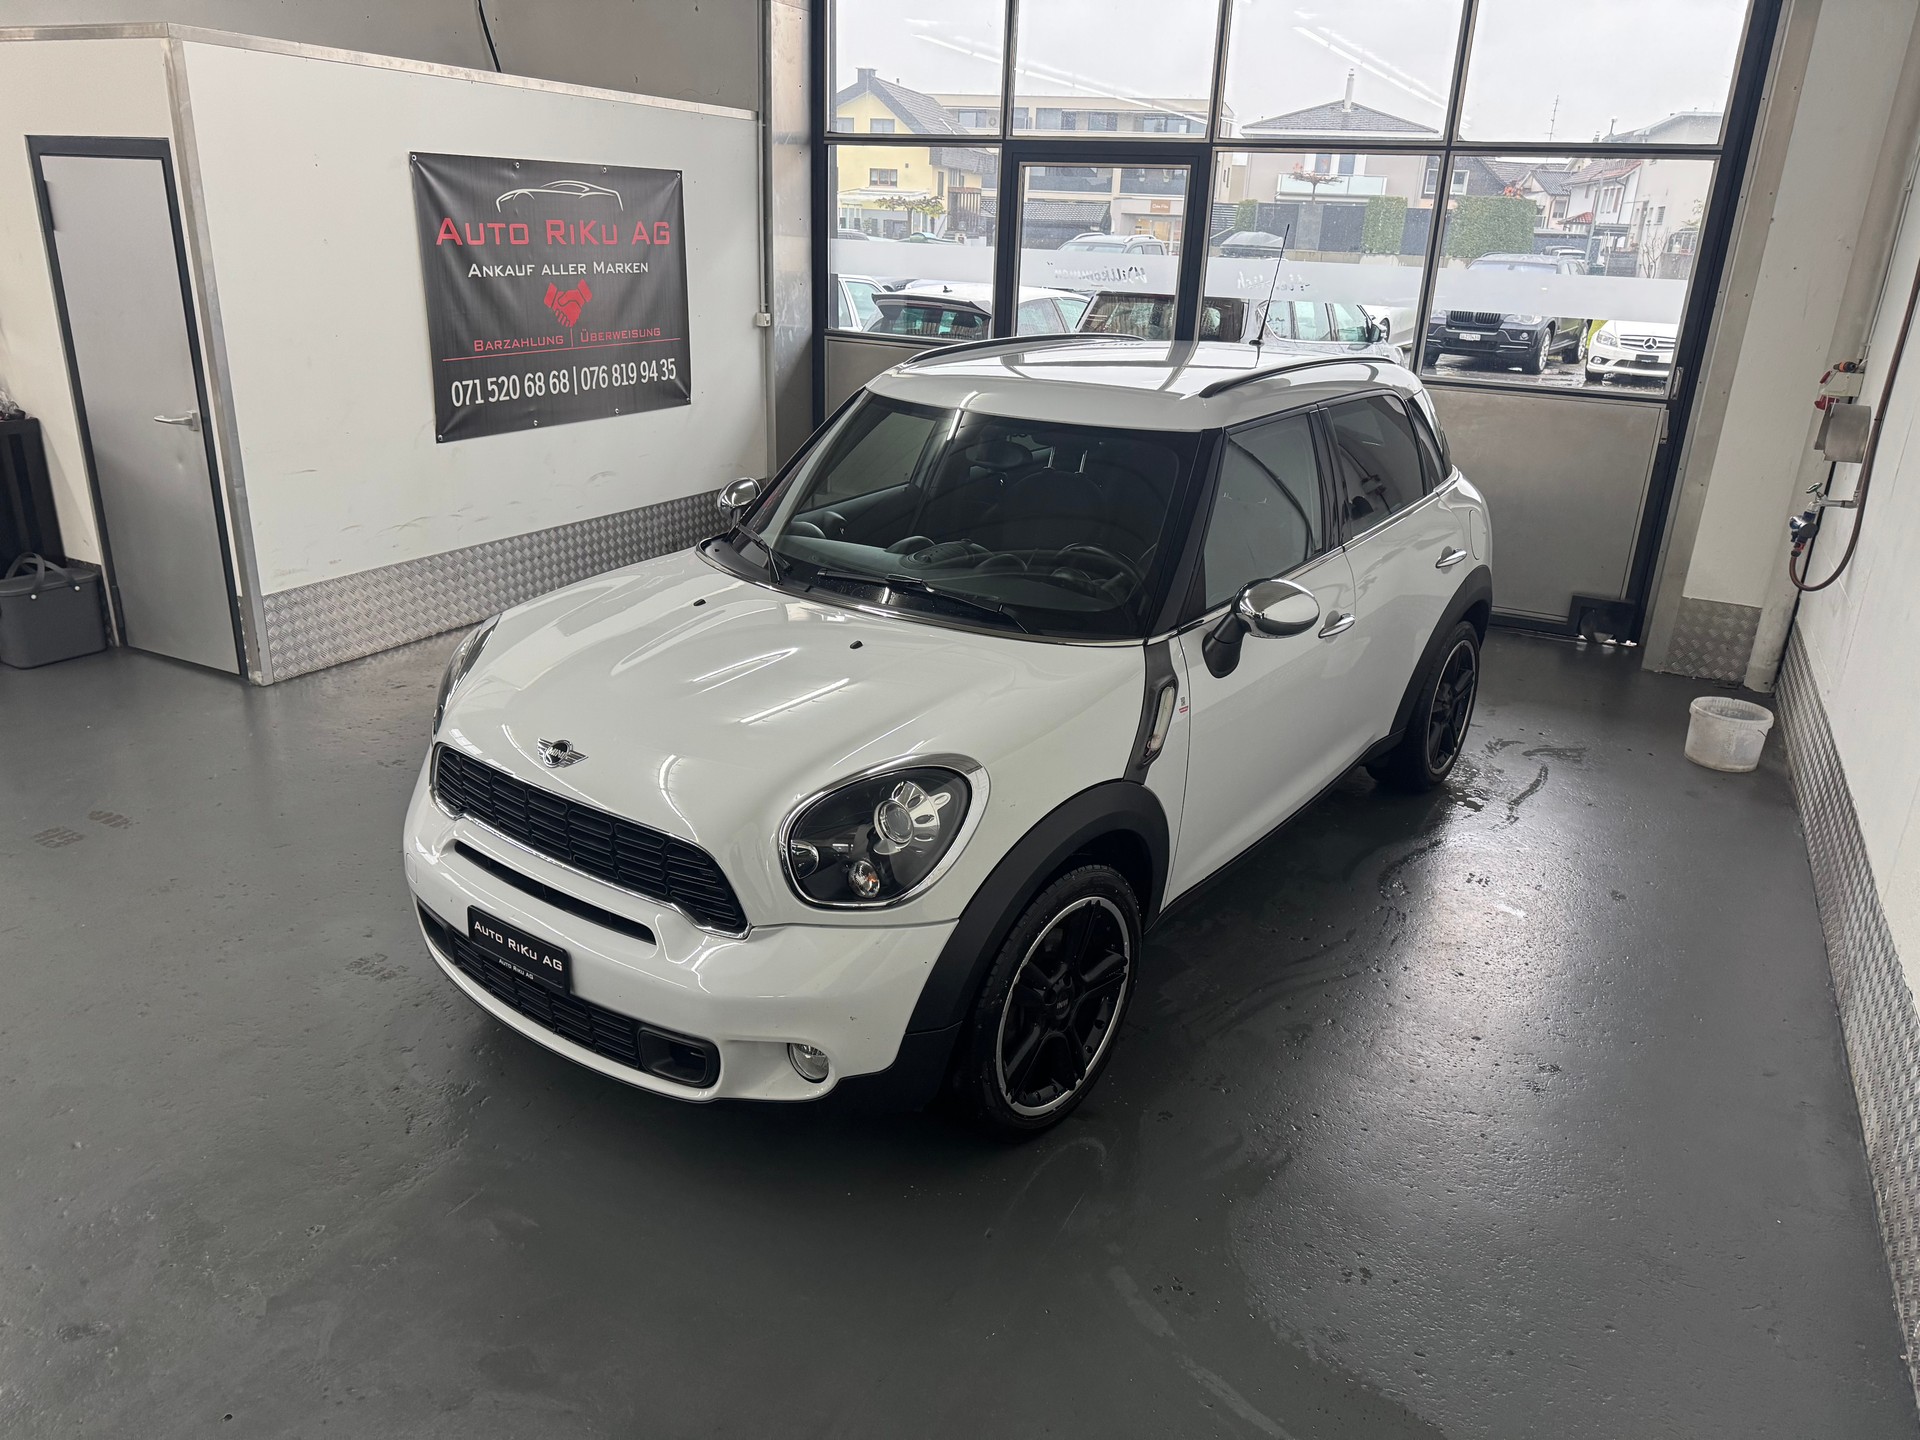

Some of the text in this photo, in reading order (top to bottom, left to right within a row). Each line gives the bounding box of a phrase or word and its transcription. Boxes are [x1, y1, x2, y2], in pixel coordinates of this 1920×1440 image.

[436, 217, 529, 246] AUTO
[631, 221, 670, 246] AG
[468, 261, 649, 278] ANKAUF ALLER MARKEN
[473, 327, 661, 352] BARZAHLUNG ÜBERWEISUNG
[451, 358, 677, 408] 071 520 68 68 076 819 94 35
[474, 921, 503, 944] AUTO
[542, 955, 563, 971] AG
[499, 959, 512, 969] AUTO
